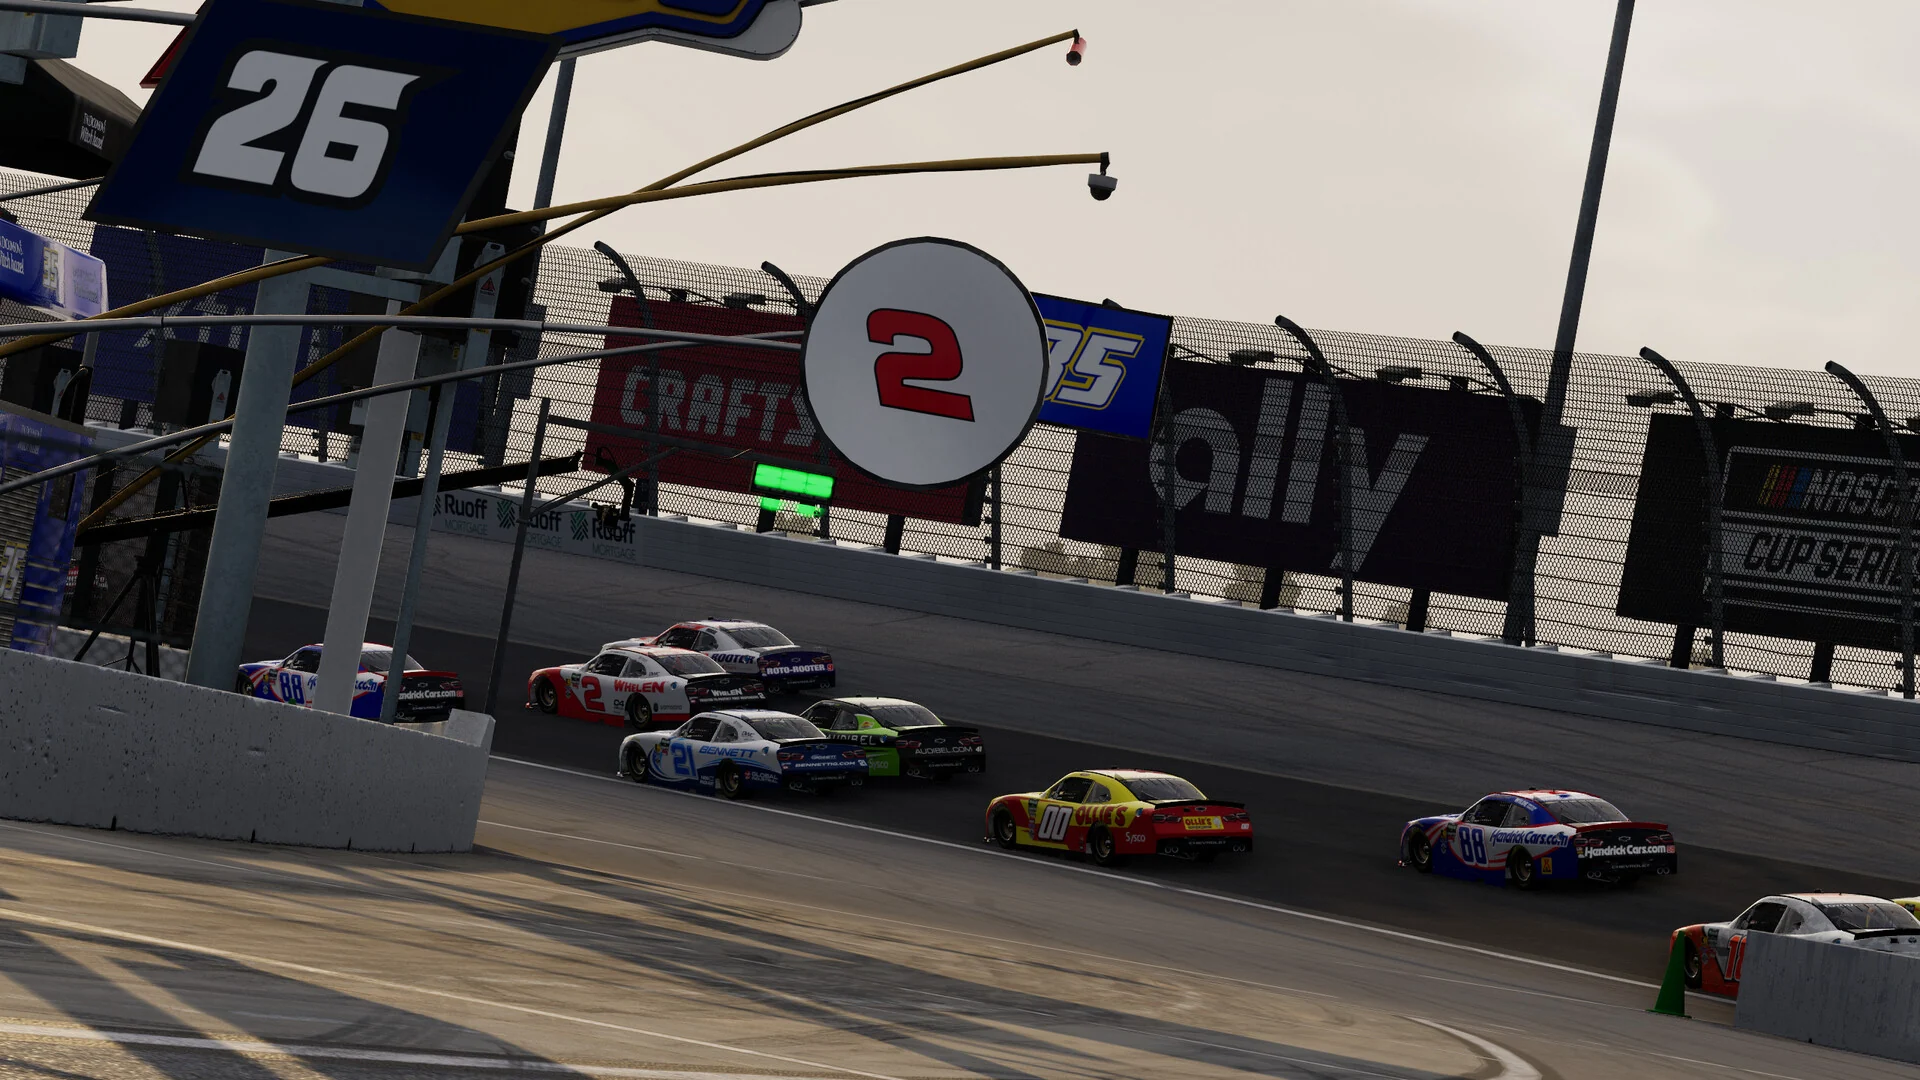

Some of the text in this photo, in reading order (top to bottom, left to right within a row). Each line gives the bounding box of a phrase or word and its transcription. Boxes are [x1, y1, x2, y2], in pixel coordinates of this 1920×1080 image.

[192, 49, 421, 200] 26
[866, 307, 975, 423] 2
[620, 365, 816, 447] CRAFTS
[1150, 378, 1430, 573] ally
[444, 494, 488, 520] Ruoff
[520, 507, 562, 532] uoff
[444, 518, 488, 536] MORTGAGE
[525, 533, 562, 548] ORTGAGE
[592, 542, 636, 561] MORTGAGE
[1743, 531, 1816, 574] CUP
[766, 663, 826, 675] ROTO-ROOTER
[280, 672, 305, 705] 88
[581, 675, 606, 712] 2
[613, 679, 666, 694] WHELEN
[671, 742, 697, 777] 21
[698, 744, 757, 758] BENNETT
[914, 746, 973, 756] AUDIBEL.COM
[1038, 805, 1074, 842] 00
[1075, 804, 1129, 827] OLLIE'S
[1459, 826, 1488, 864] 88
[1584, 844, 1667, 860] HendrickCars.com
